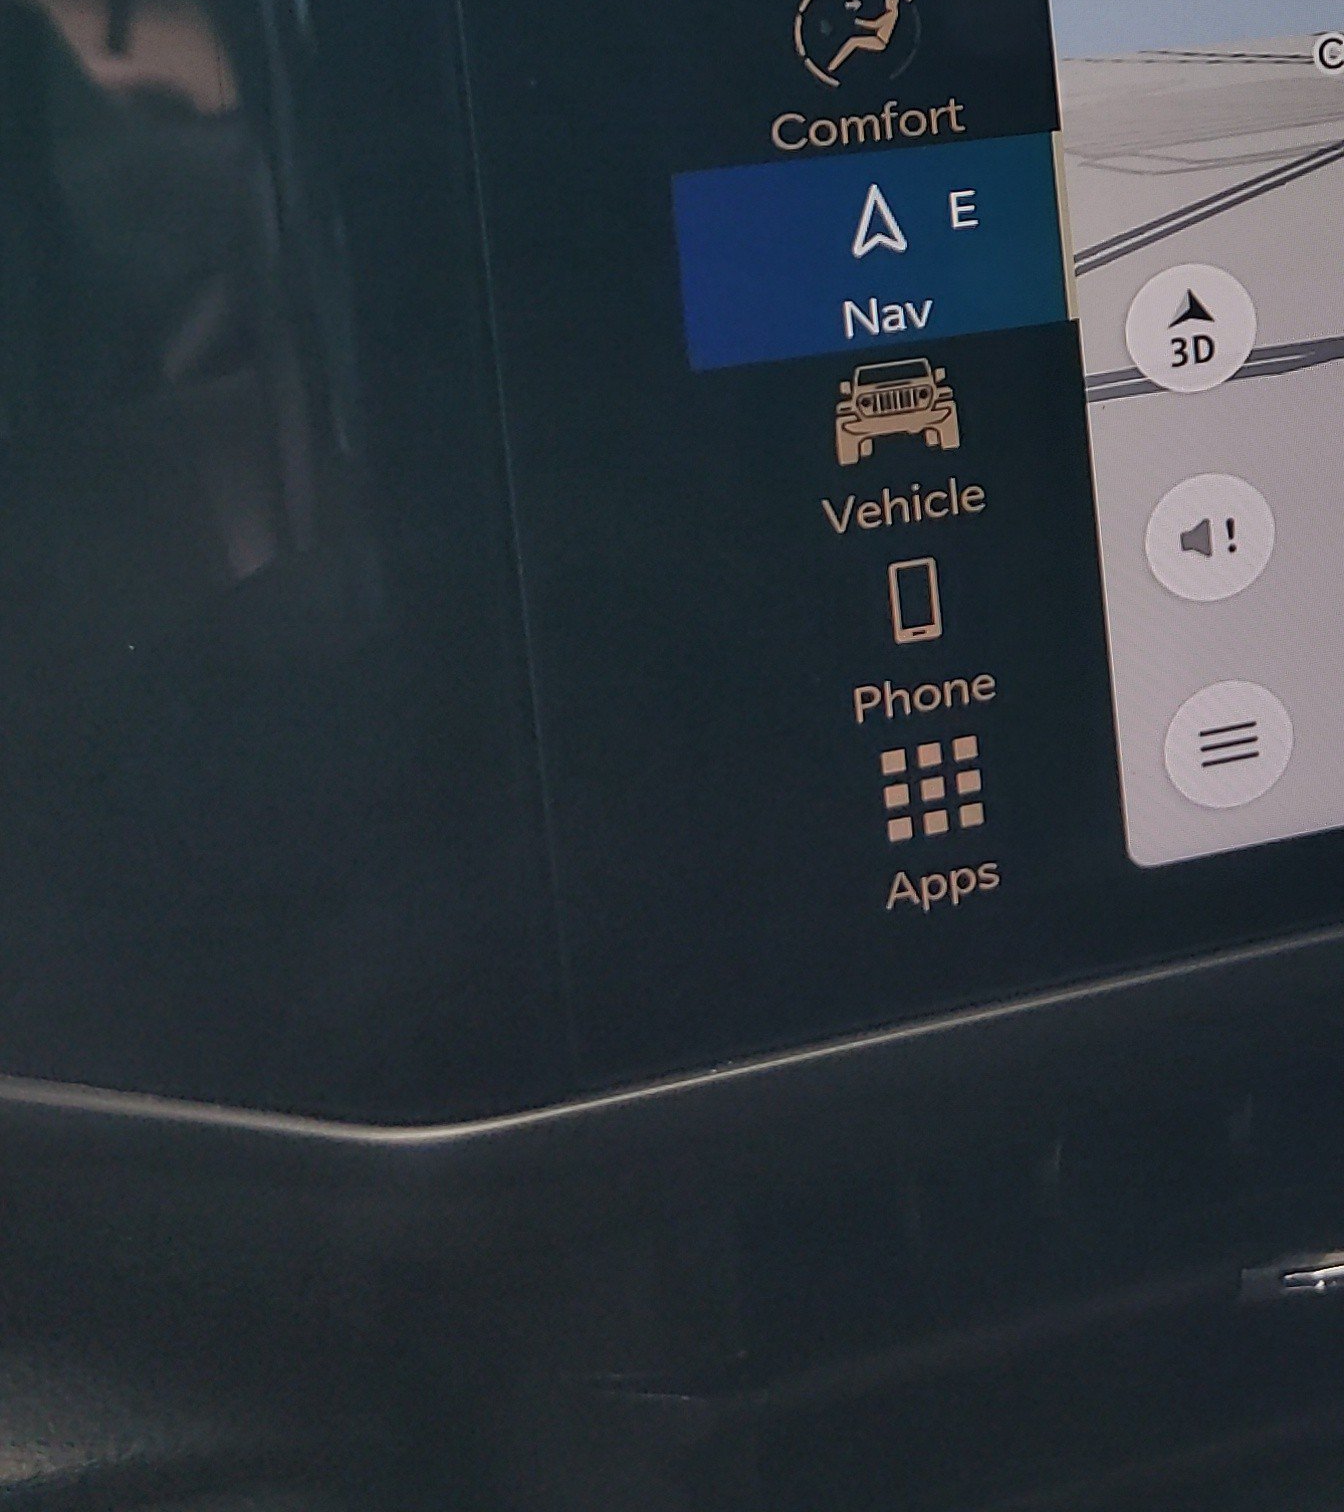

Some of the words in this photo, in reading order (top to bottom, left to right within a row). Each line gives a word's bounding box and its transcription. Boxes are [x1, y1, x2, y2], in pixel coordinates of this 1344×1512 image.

[771, 98, 967, 153] Comfort
[950, 190, 979, 229] E
[841, 298, 933, 340] Nav
[1171, 334, 1216, 368] 3D
[822, 478, 986, 535] Vehicle
[852, 669, 998, 725] Phone
[885, 857, 1000, 913] Apps
